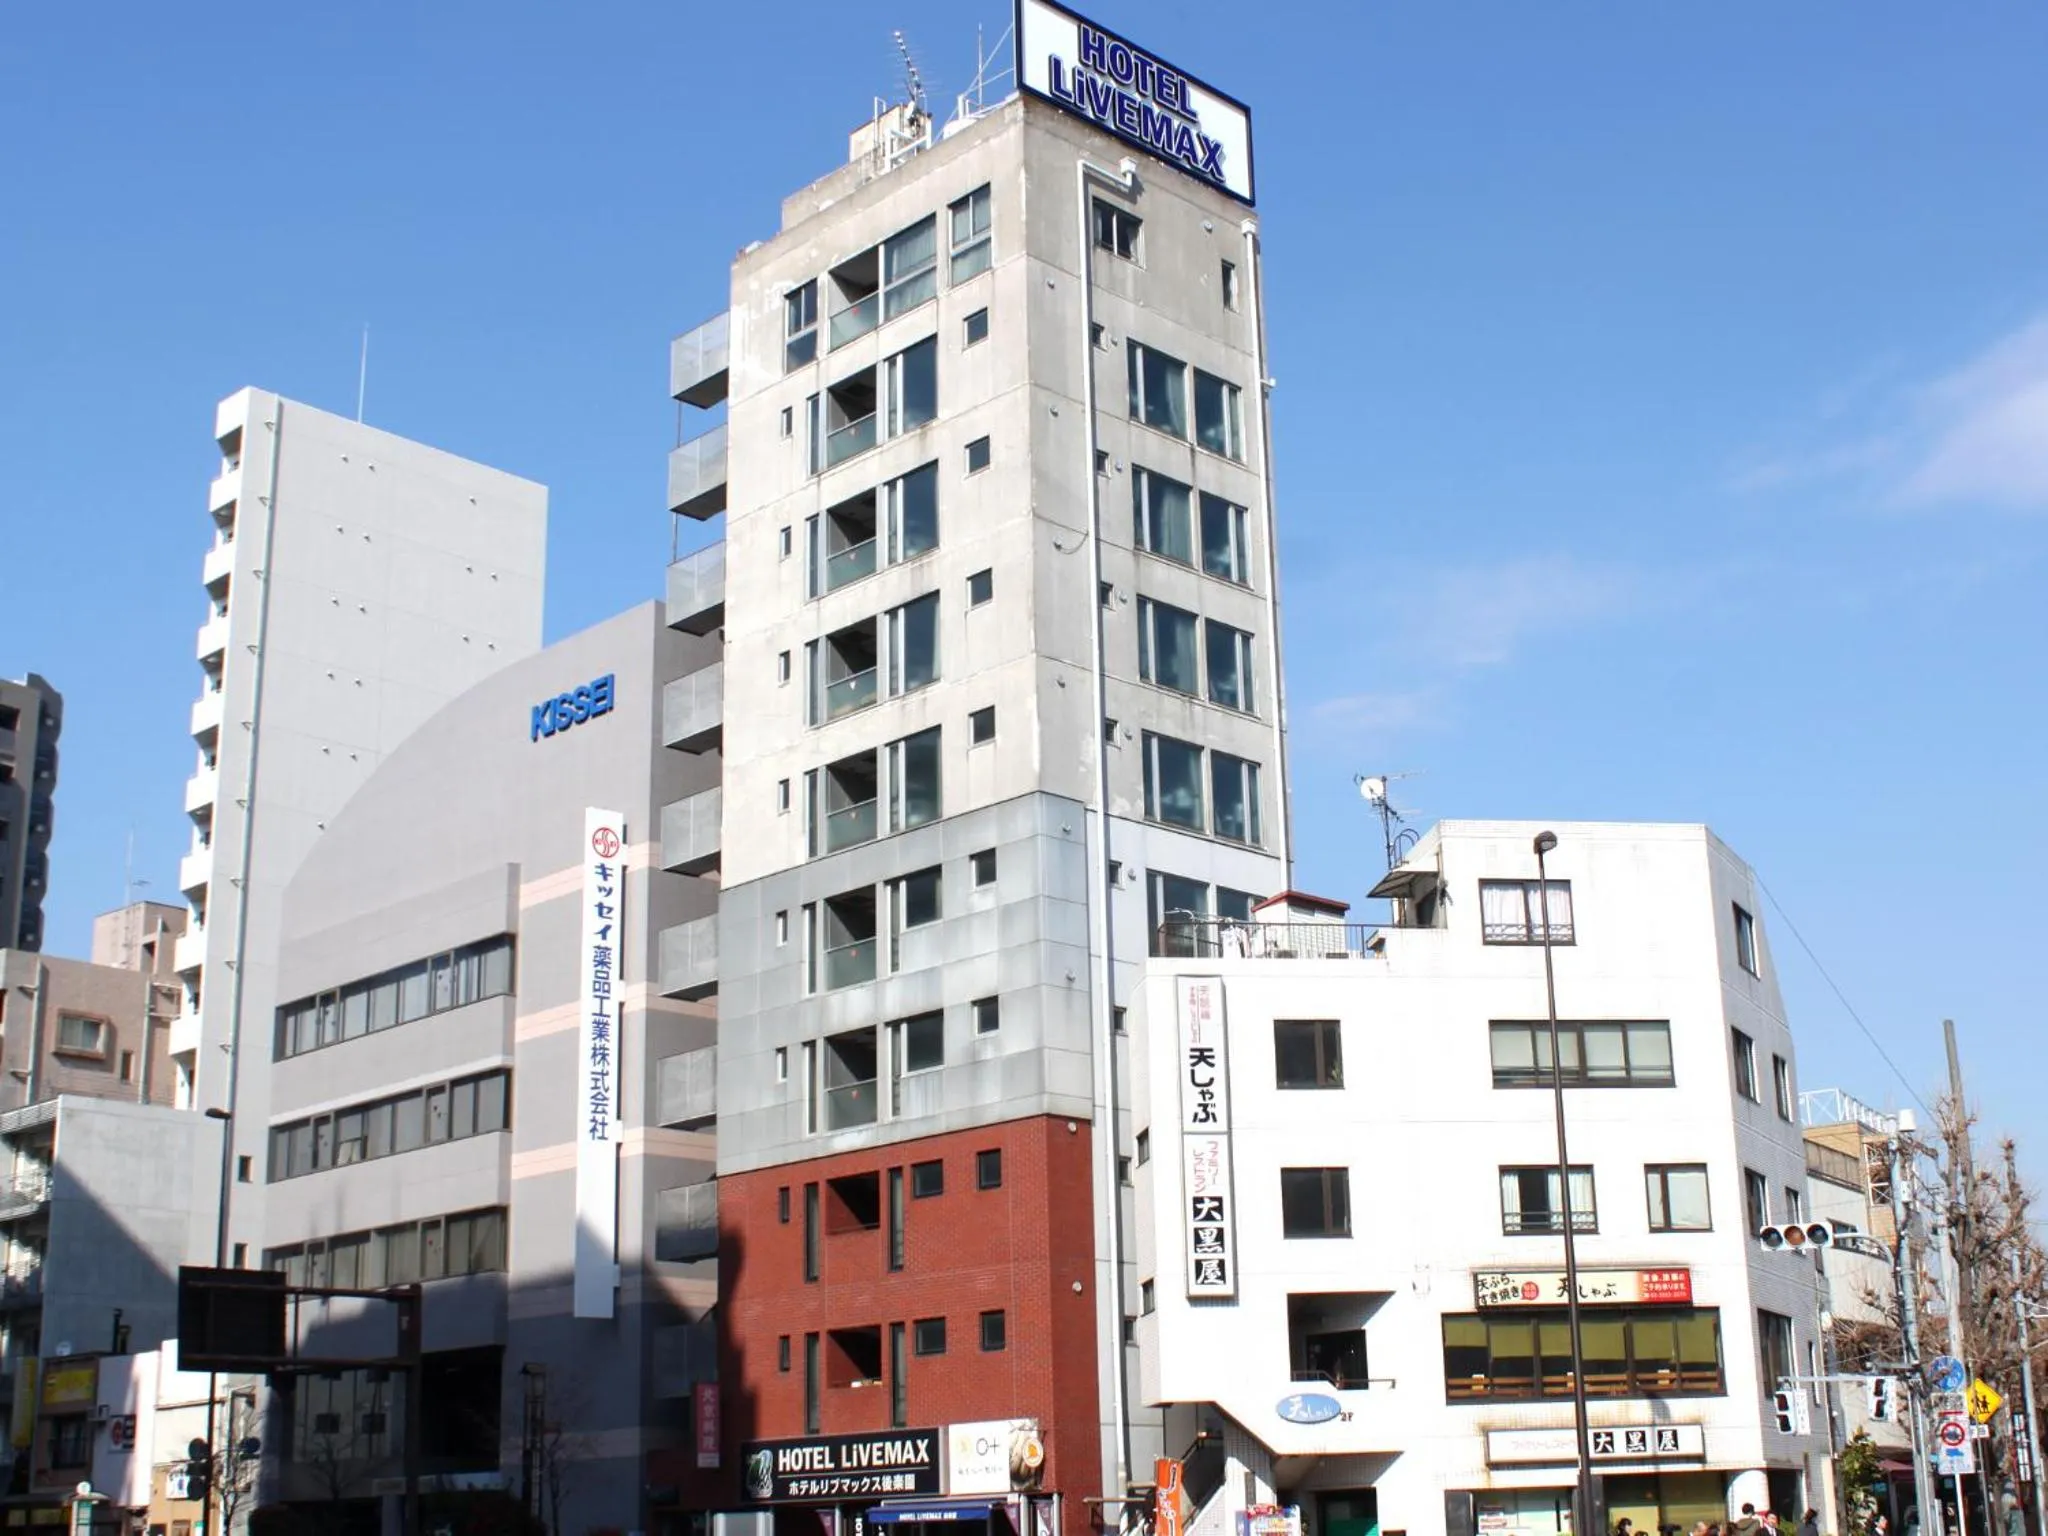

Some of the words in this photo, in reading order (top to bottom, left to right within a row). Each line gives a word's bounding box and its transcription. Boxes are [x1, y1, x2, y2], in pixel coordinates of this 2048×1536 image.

[1080, 24, 1199, 122] HOTEL
[530, 673, 615, 743] KISSEI
[590, 863, 613, 1141] キッセイ薬品工業株式会社
[1189, 1047, 1217, 1123] 天しゃぶ
[1193, 1196, 1225, 1285] 大黒屋
[778, 1446, 834, 1472] HOTEL
[1594, 1429, 1679, 1453] 大黒屋
[789, 1474, 916, 1496] ホテルリブマックス後楽園
